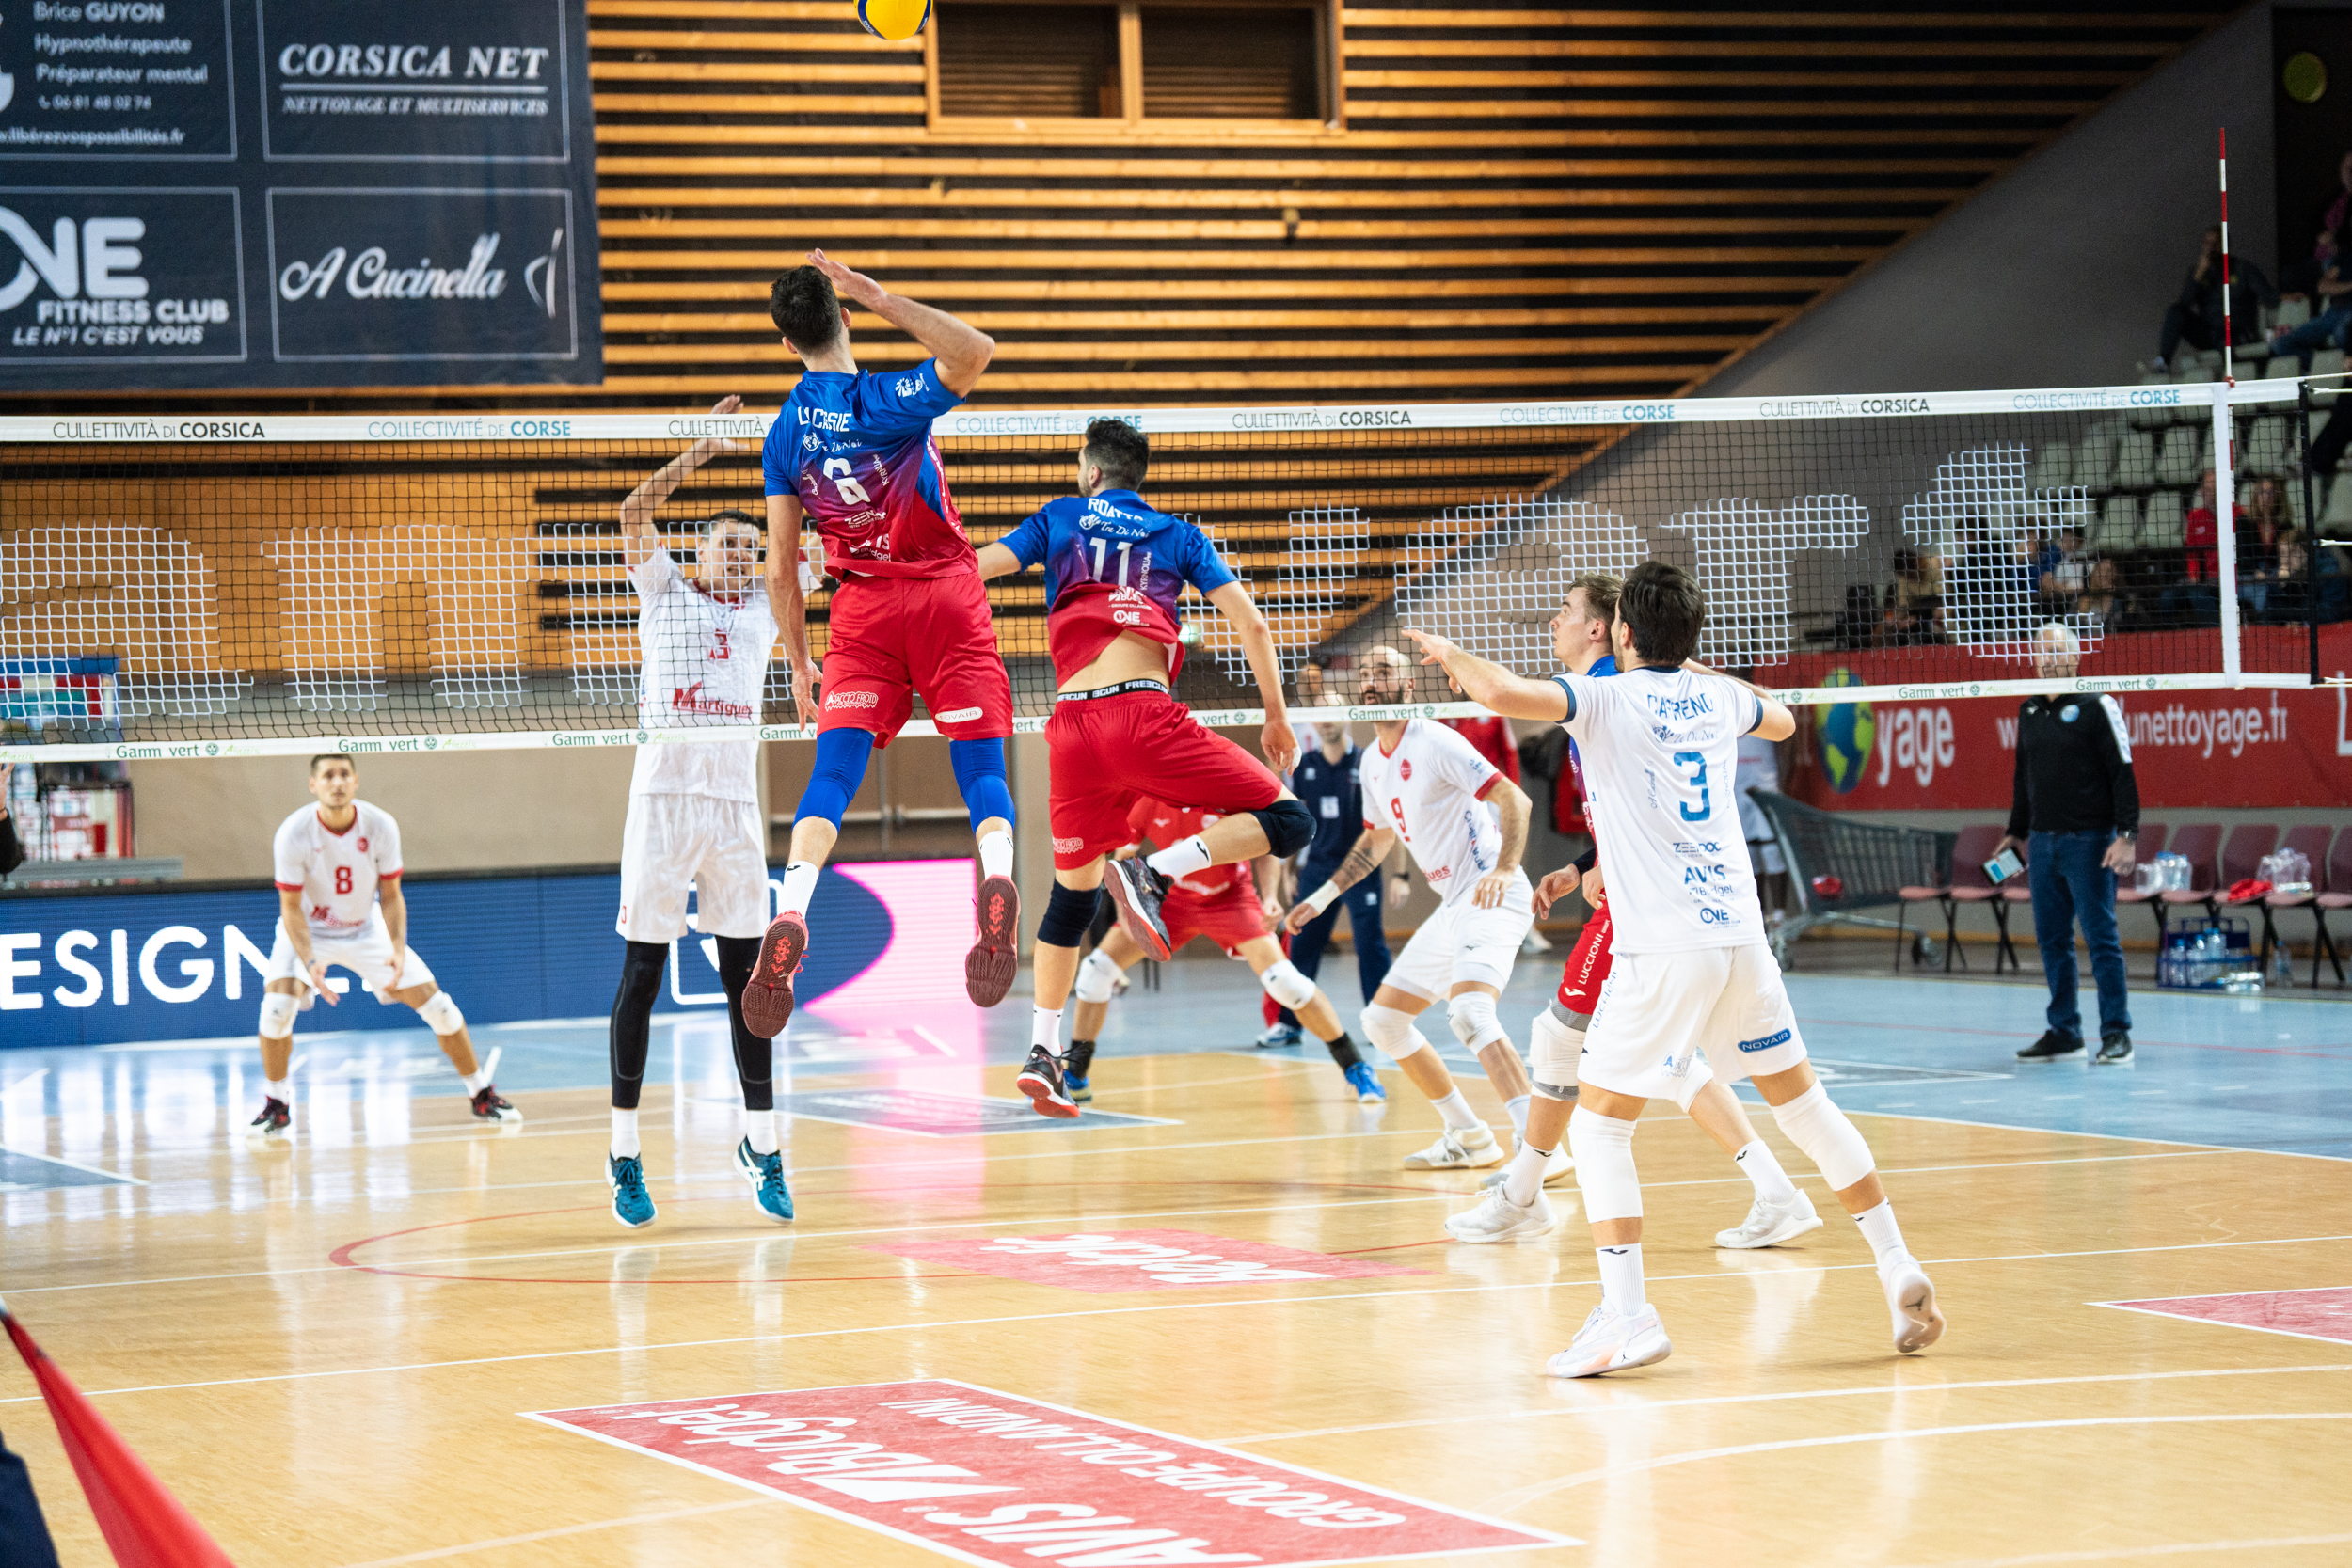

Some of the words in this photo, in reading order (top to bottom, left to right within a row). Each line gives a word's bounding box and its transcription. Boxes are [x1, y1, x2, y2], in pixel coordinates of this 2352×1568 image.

[34, 1, 82, 21] Brice
[85, 2, 165, 23] GUYON
[34, 33, 192, 55] Hypnothérapeute
[279, 43, 453, 78] CORSICA
[465, 46, 549, 79] NET
[36, 63, 143, 86] Préparateur
[147, 64, 208, 84] mental
[388, 96, 414, 115] ET
[280, 246, 346, 301] A
[346, 232, 507, 299] Cucinella
[37, 299, 151, 325] FITNESS
[155, 298, 230, 324] CLUB
[12, 326, 40, 346] LE
[146, 325, 204, 345] VOUS
[1760, 397, 1843, 417] CULLETTIVITÀ
[1847, 403, 1857, 414] DI
[1861, 398, 1930, 414] CORSICA
[2013, 388, 2107, 410] COLLECTIVITÉ
[2112, 394, 2126, 406] DE
[2130, 389, 2181, 405] CORSE
[956, 413, 1061, 433] COLLECTIVITÉ
[1066, 419, 1081, 432] DE
[1232, 407, 1320, 429] CULLETTIVITÀ
[1325, 416, 1336, 427] DI
[1339, 411, 1412, 427] CORSICA
[1501, 403, 1599, 422] COLLECTIVITÉ
[1603, 408, 1618, 420] DE
[1623, 405, 1675, 420] CORSE
[53, 420, 158, 439] CULLETTIVITÀ
[163, 425, 176, 438] DI
[180, 422, 265, 438] CORSICA
[368, 418, 483, 438] COLLECTIVITÉ
[487, 424, 505, 437] DE
[511, 420, 571, 436] CORSE
[669, 416, 765, 436] CULLETTIVITÀ
[823, 457, 872, 505] 6
[1089, 537, 1133, 587] 11
[1899, 687, 1934, 699] Gamm
[1941, 685, 1964, 697] vert
[2076, 680, 2112, 691] Gamm
[2117, 678, 2141, 689] vert
[1202, 712, 1229, 724] vert
[1348, 707, 1387, 721] Gamm
[1392, 705, 1418, 719] vert
[552, 733, 595, 747] Gamm
[602, 732, 630, 745] vert
[760, 727, 802, 740] Gamm
[117, 745, 161, 759] Gamm
[169, 743, 199, 757] vert
[339, 739, 382, 753] Gamm
[389, 736, 419, 751] vert
[1673, 752, 1710, 821] 3
[335, 866, 353, 895] 8
[1578, 933, 1604, 985] LUCCIONI
[1742, 1032, 1788, 1051] NOVAIR
[611, 1403, 934, 1476] Budget
[878, 1397, 1178, 1465] OLLANDINI
[1120, 1463, 1407, 1528] GROUPE
